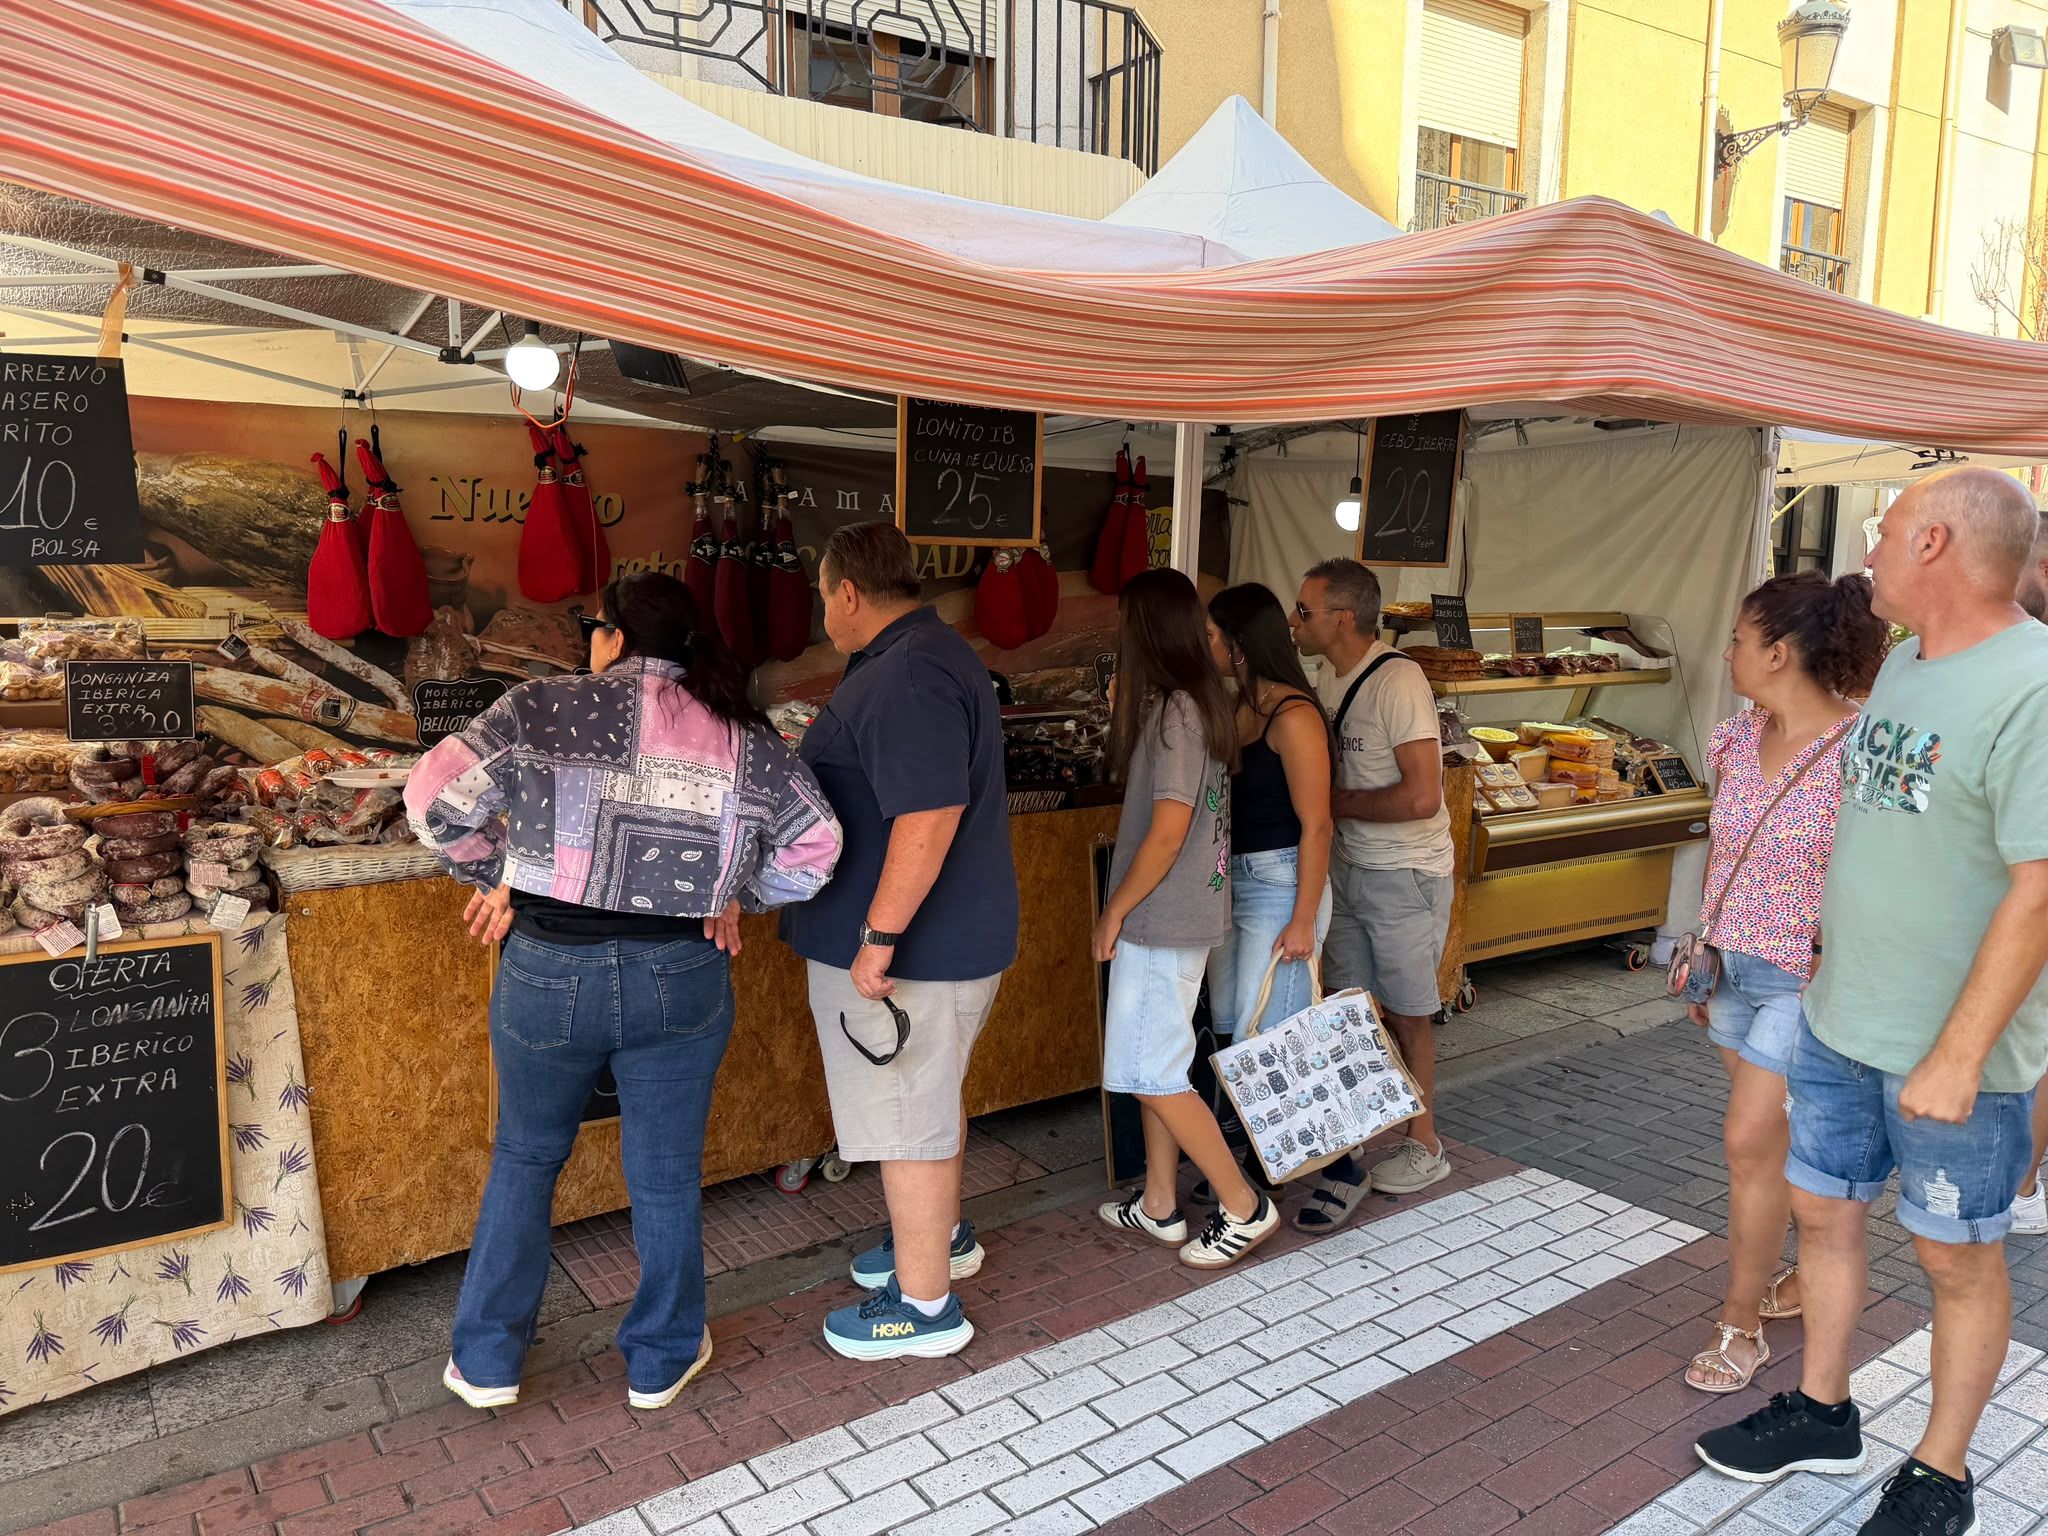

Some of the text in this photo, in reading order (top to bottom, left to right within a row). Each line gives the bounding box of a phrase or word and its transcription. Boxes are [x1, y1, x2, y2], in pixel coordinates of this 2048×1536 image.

[0, 417, 73, 445] RITO
[916, 416, 1015, 444] LOMITO IB
[31, 537, 100, 558] BOLSA
[70, 666, 170, 686] LONGANIZA
[78, 684, 162, 701] IBERICA
[81, 702, 146, 715] EXTRA
[422, 697, 484, 710] IBERICO
[1342, 736, 1364, 752] ENCE
[50, 951, 171, 993] OFERTA
[64, 1032, 194, 1070] IBERICO
[54, 1067, 177, 1113] EXTRA
[872, 1321, 916, 1339] HOKA
